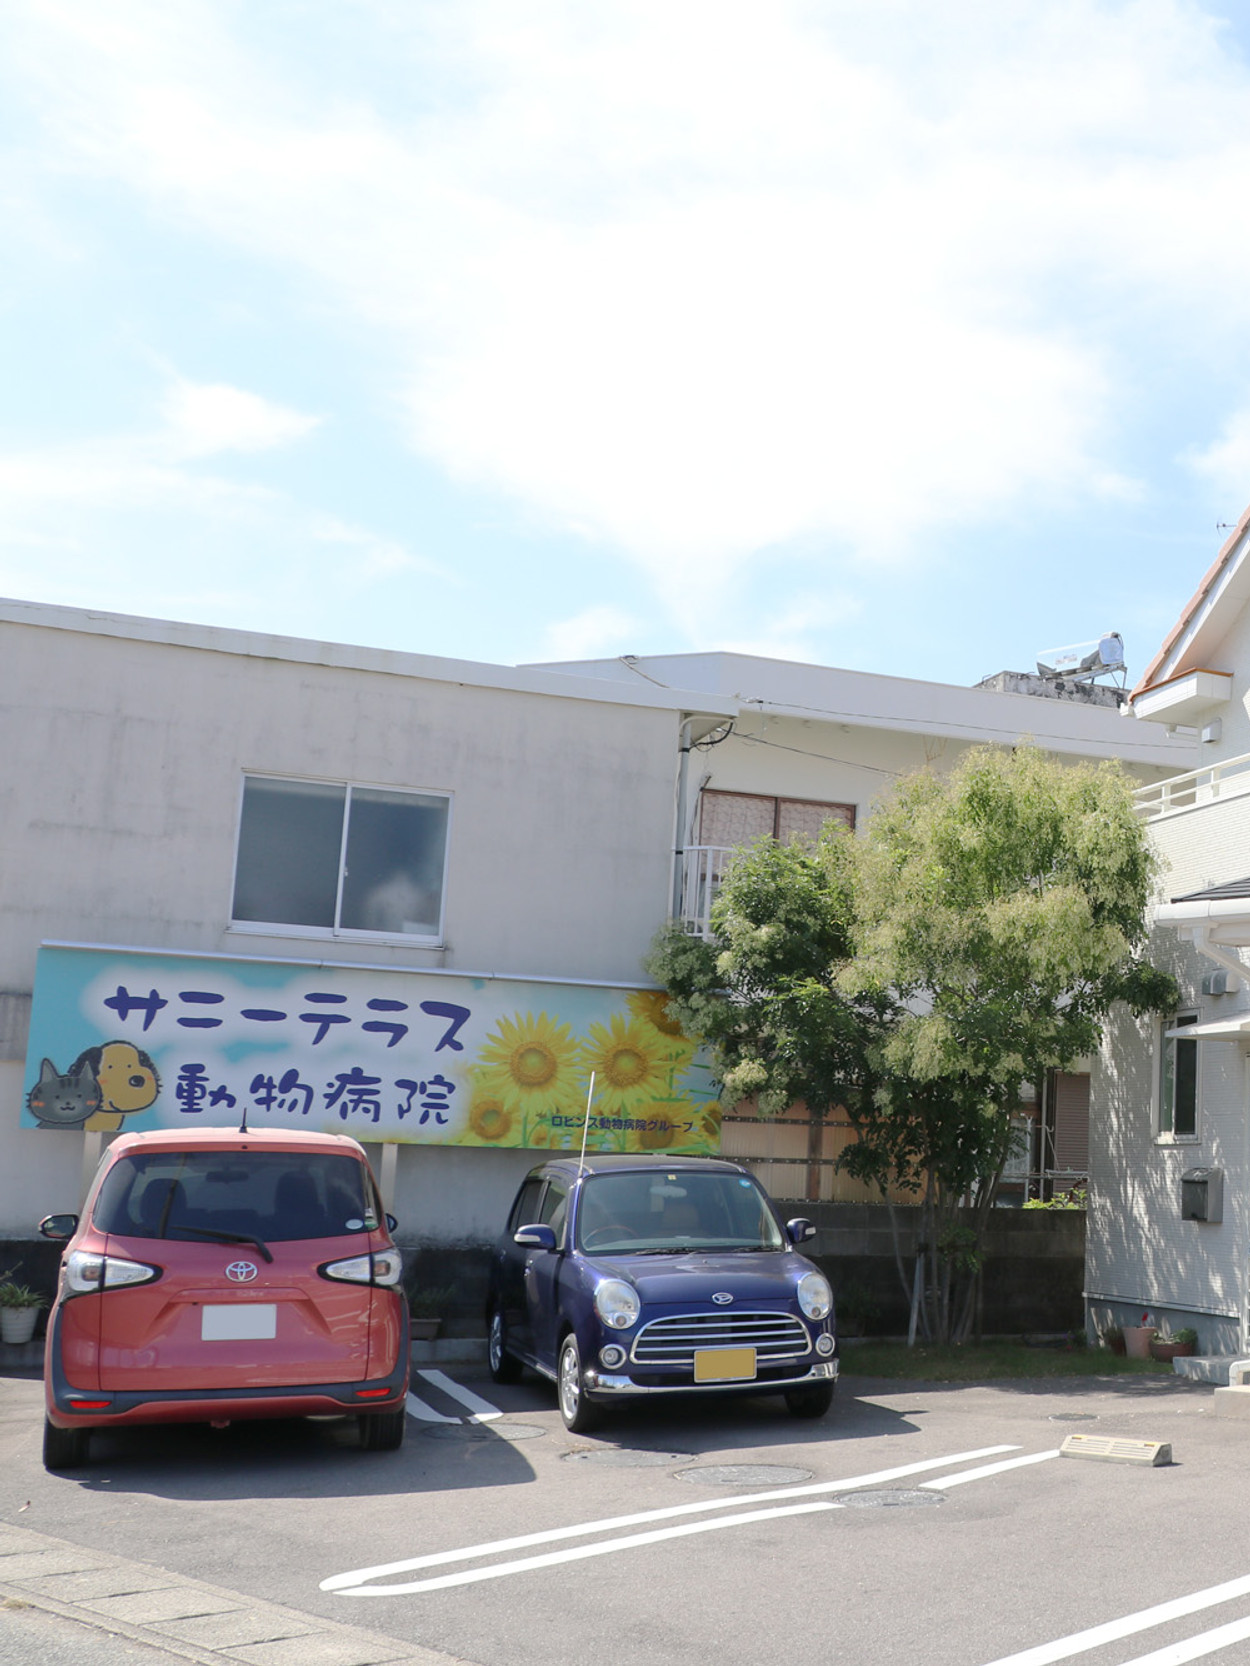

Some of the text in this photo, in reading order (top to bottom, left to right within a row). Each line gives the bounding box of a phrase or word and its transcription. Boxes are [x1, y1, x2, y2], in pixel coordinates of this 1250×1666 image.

[104, 985, 472, 1052] サニーテラス
[174, 1063, 457, 1125] 動物病院
[551, 1115, 694, 1133] ロビンス動物病院グループ
